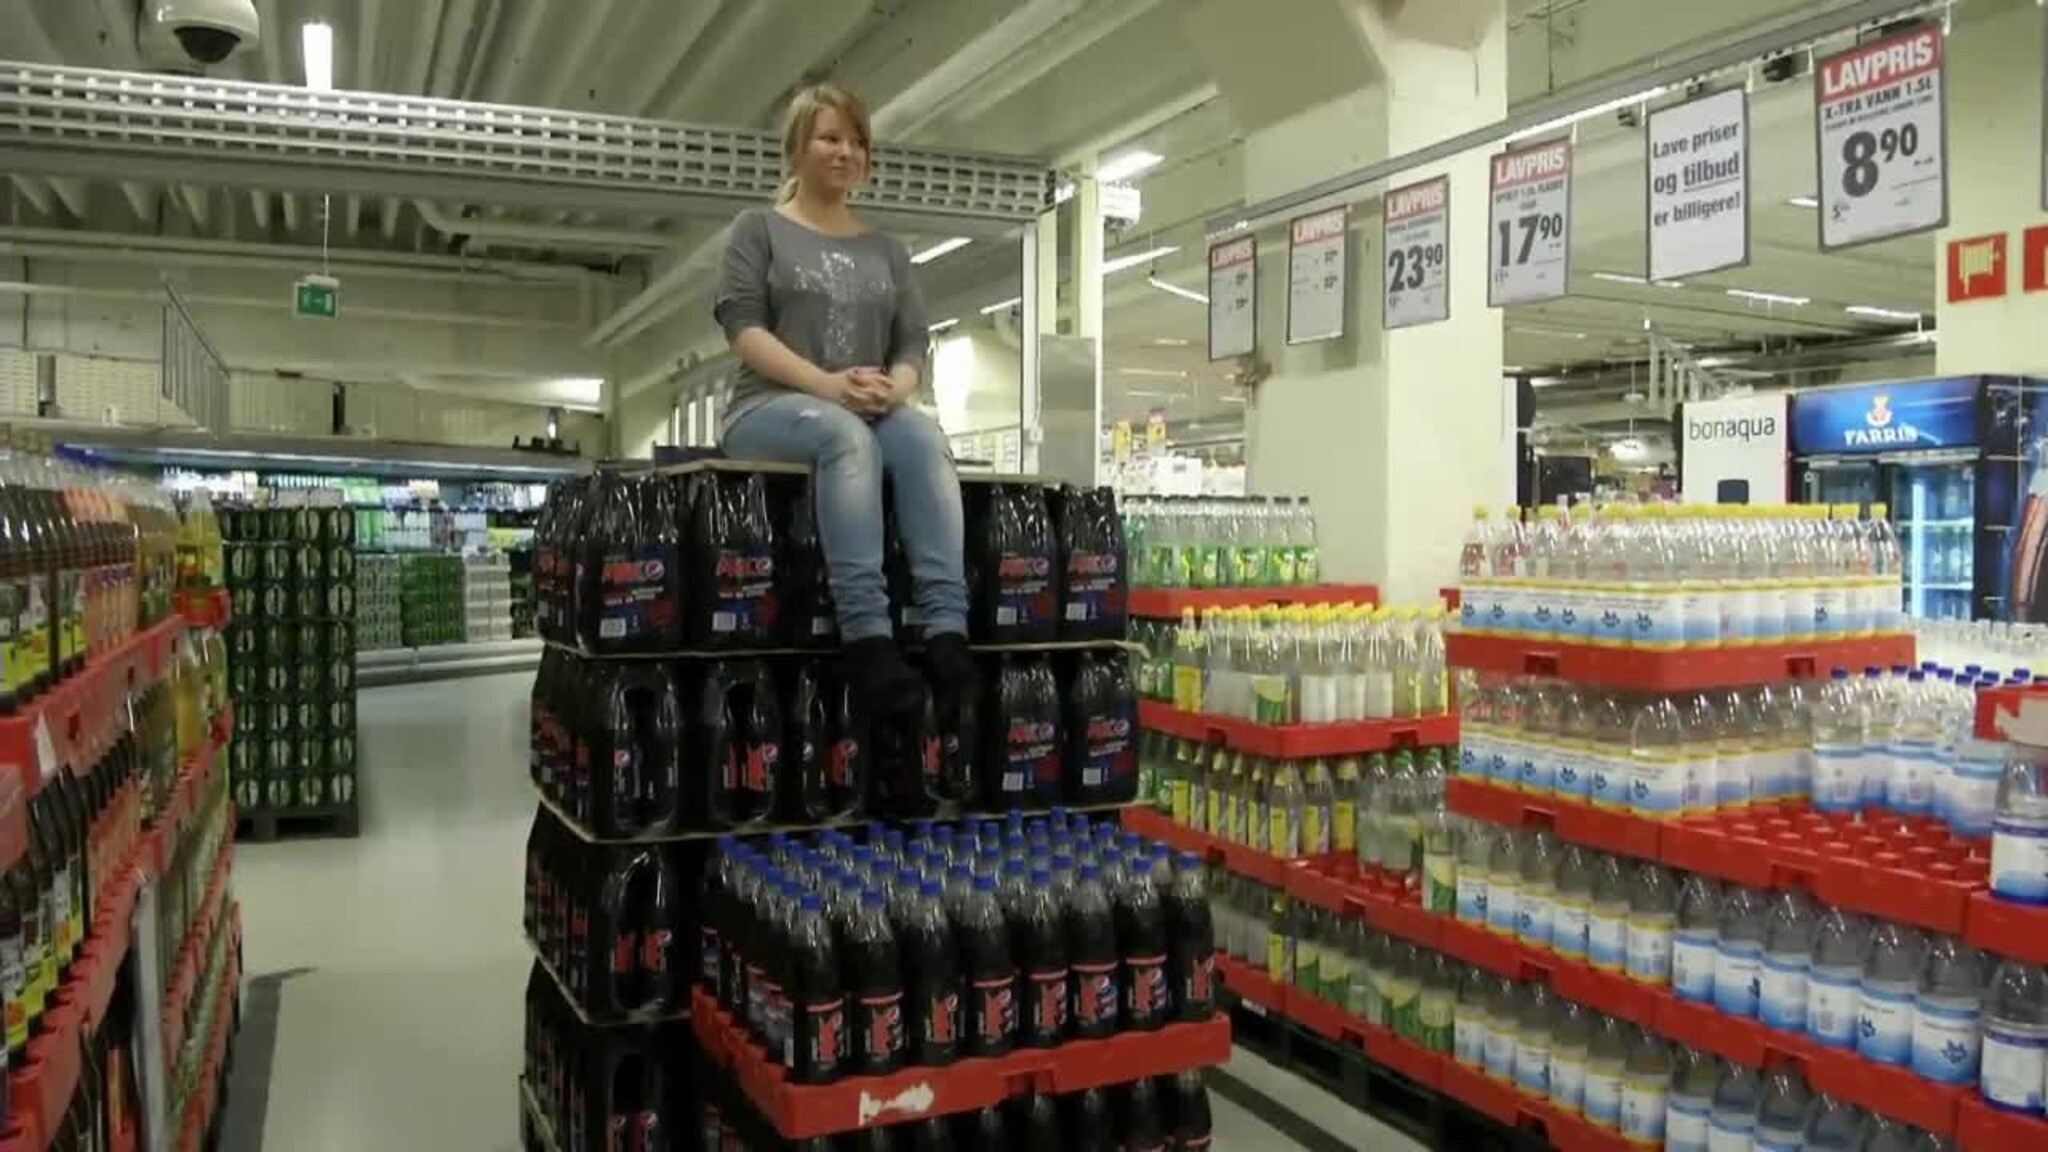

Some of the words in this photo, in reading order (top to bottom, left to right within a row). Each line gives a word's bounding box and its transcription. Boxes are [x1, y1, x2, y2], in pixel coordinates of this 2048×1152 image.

[1824, 35, 1933, 95] LAVPRIS
[1825, 97, 1861, 120] X-TRA
[1867, 86, 1900, 109] VANN
[1654, 138, 1688, 158] Lave
[1693, 122, 1739, 153] priser
[1497, 149, 1564, 183] LAVPRIS
[1654, 173, 1677, 195] og
[1684, 151, 1739, 186] tilbud
[1654, 211, 1669, 227] er
[1673, 192, 1739, 222] billigere!
[1689, 416, 1776, 442] bonaqua
